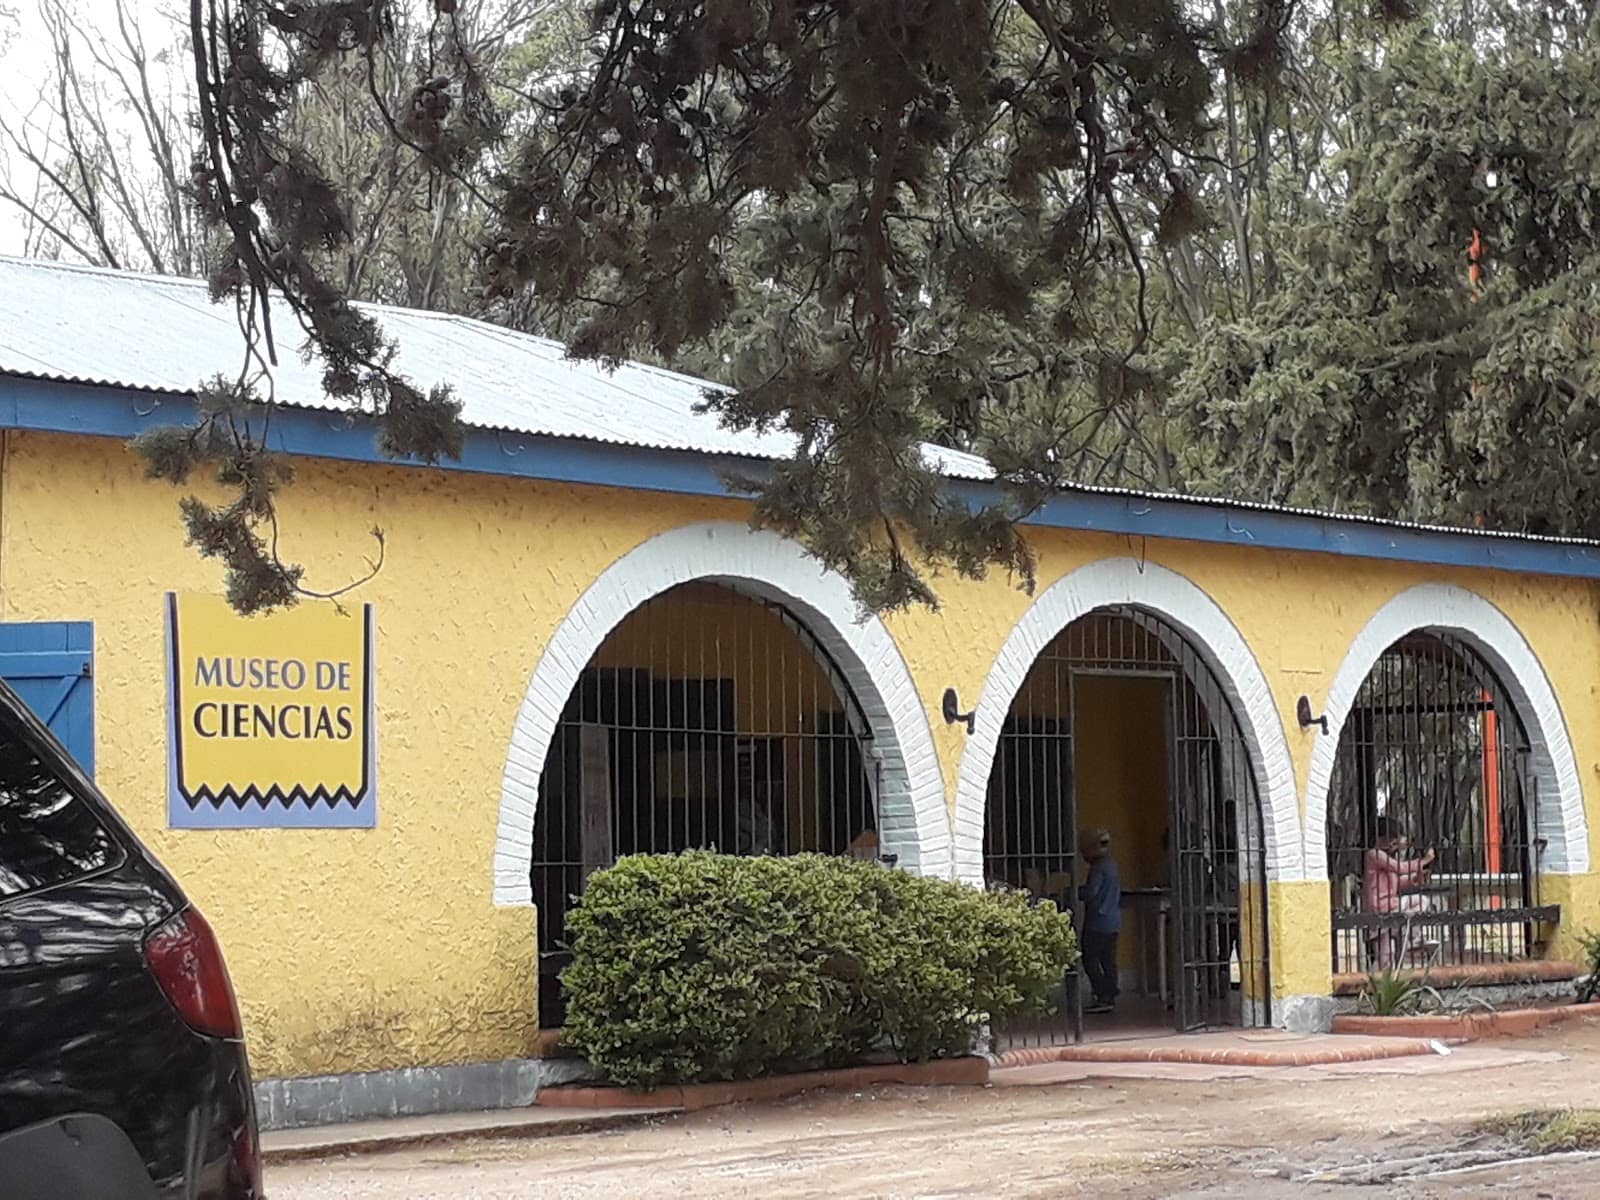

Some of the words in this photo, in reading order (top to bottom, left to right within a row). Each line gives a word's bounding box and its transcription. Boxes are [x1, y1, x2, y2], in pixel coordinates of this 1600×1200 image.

[194, 656, 306, 690] MUSEO
[315, 661, 351, 691] DE
[193, 702, 353, 740] CIENCIAS
